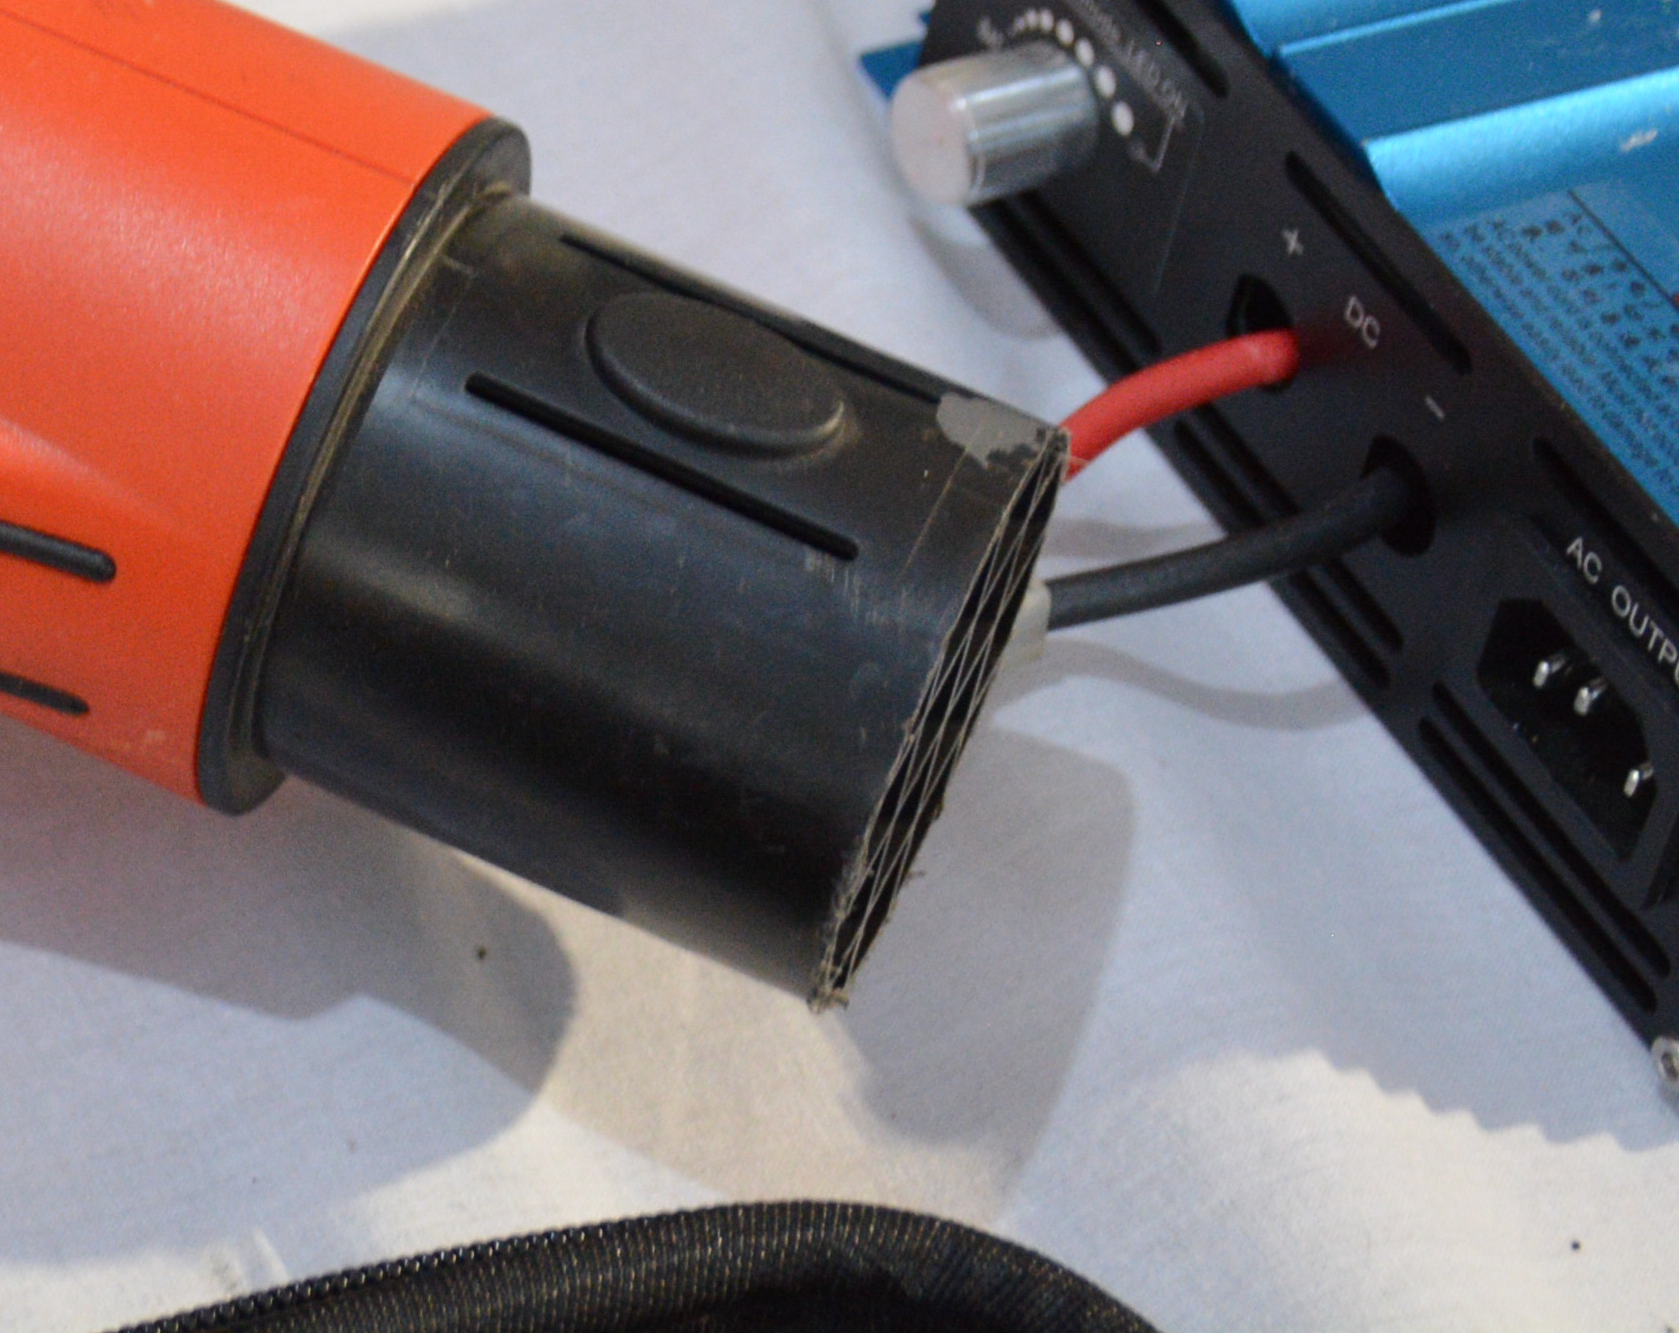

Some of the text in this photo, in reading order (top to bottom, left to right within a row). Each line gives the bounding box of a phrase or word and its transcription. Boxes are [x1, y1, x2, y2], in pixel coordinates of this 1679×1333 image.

[1344, 294, 1381, 350] DC
[1566, 535, 1679, 685] AC OUTP
